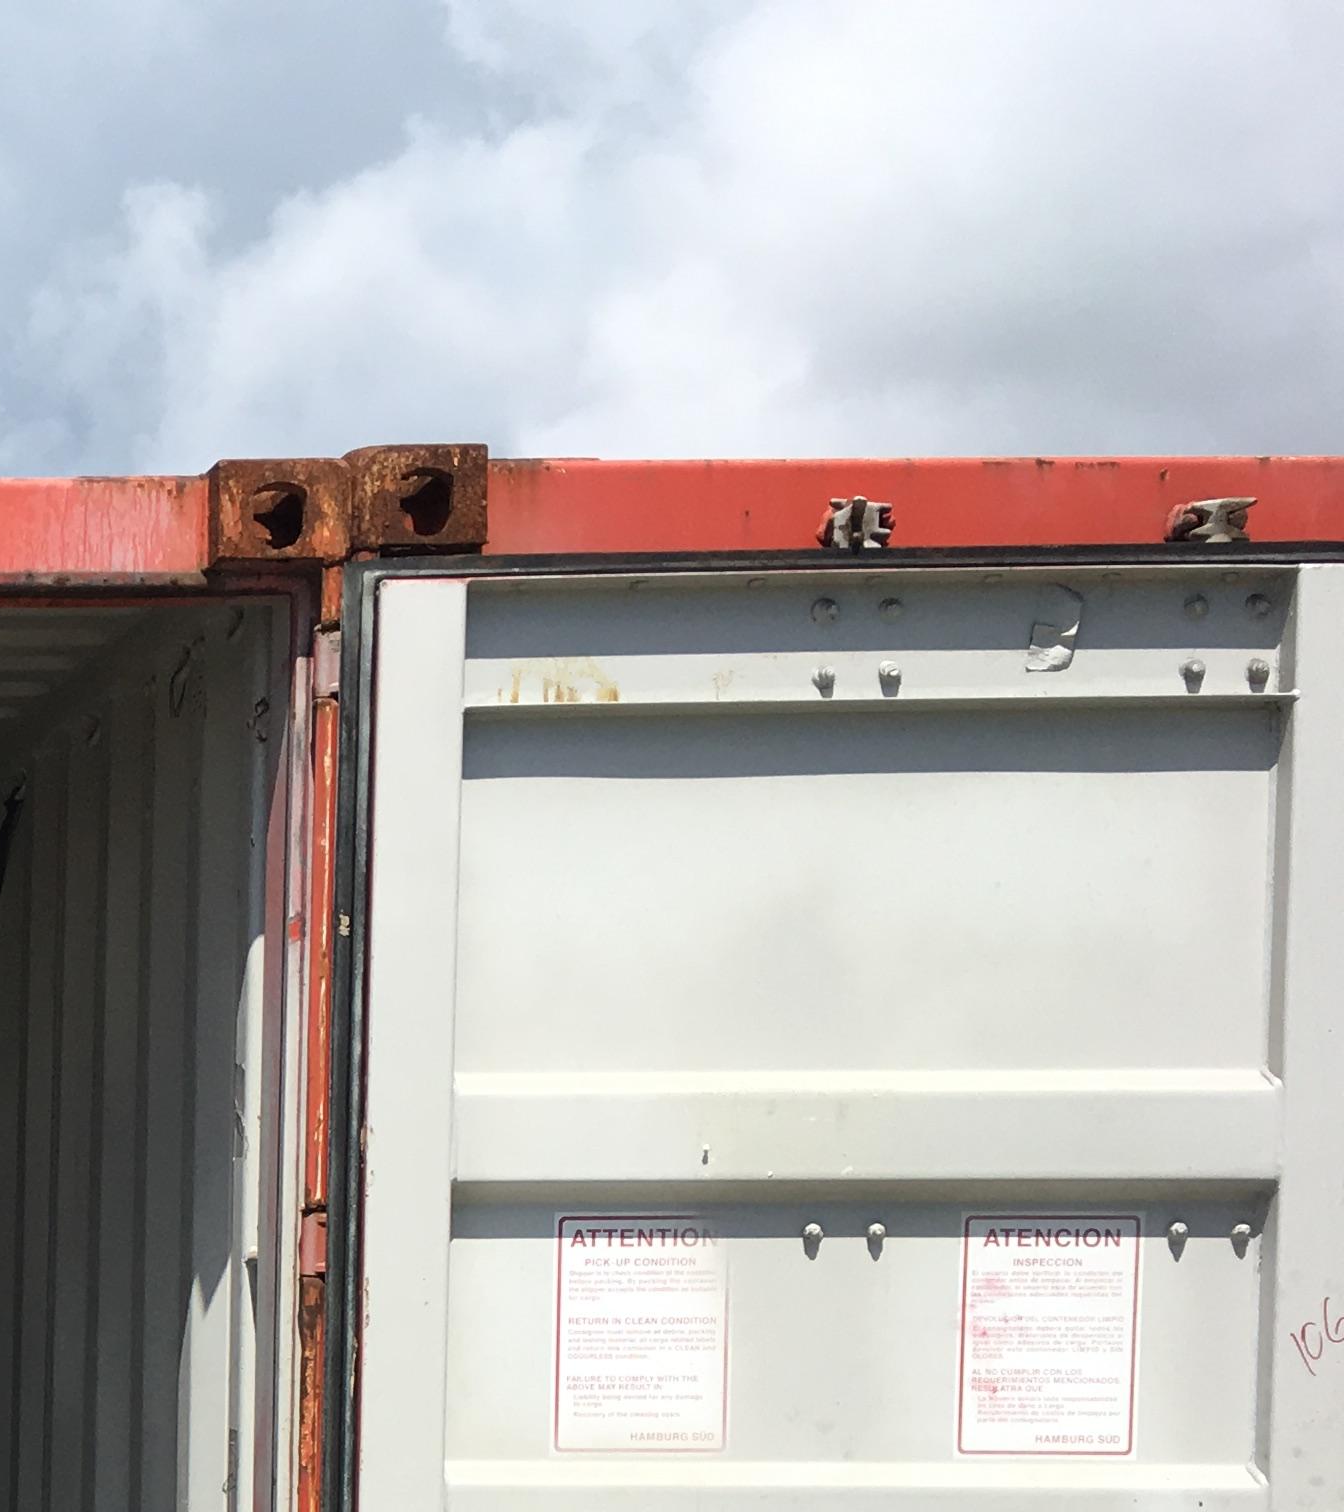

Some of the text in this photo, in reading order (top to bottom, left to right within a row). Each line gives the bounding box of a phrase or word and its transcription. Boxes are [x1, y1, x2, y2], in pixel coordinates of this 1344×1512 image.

[570, 1227, 718, 1248] ATTENTION
[983, 1227, 1121, 1248] ATENCION
[634, 1257, 696, 1267] CONDITION
[1012, 1258, 1083, 1267] INSPECCION
[568, 1317, 609, 1326] RETURN
[624, 1317, 658, 1326] CLEAN
[661, 1317, 717, 1326] CONDITION
[630, 1431, 689, 1441] HAMBURG
[1035, 1435, 1094, 1444] HAMBURG
